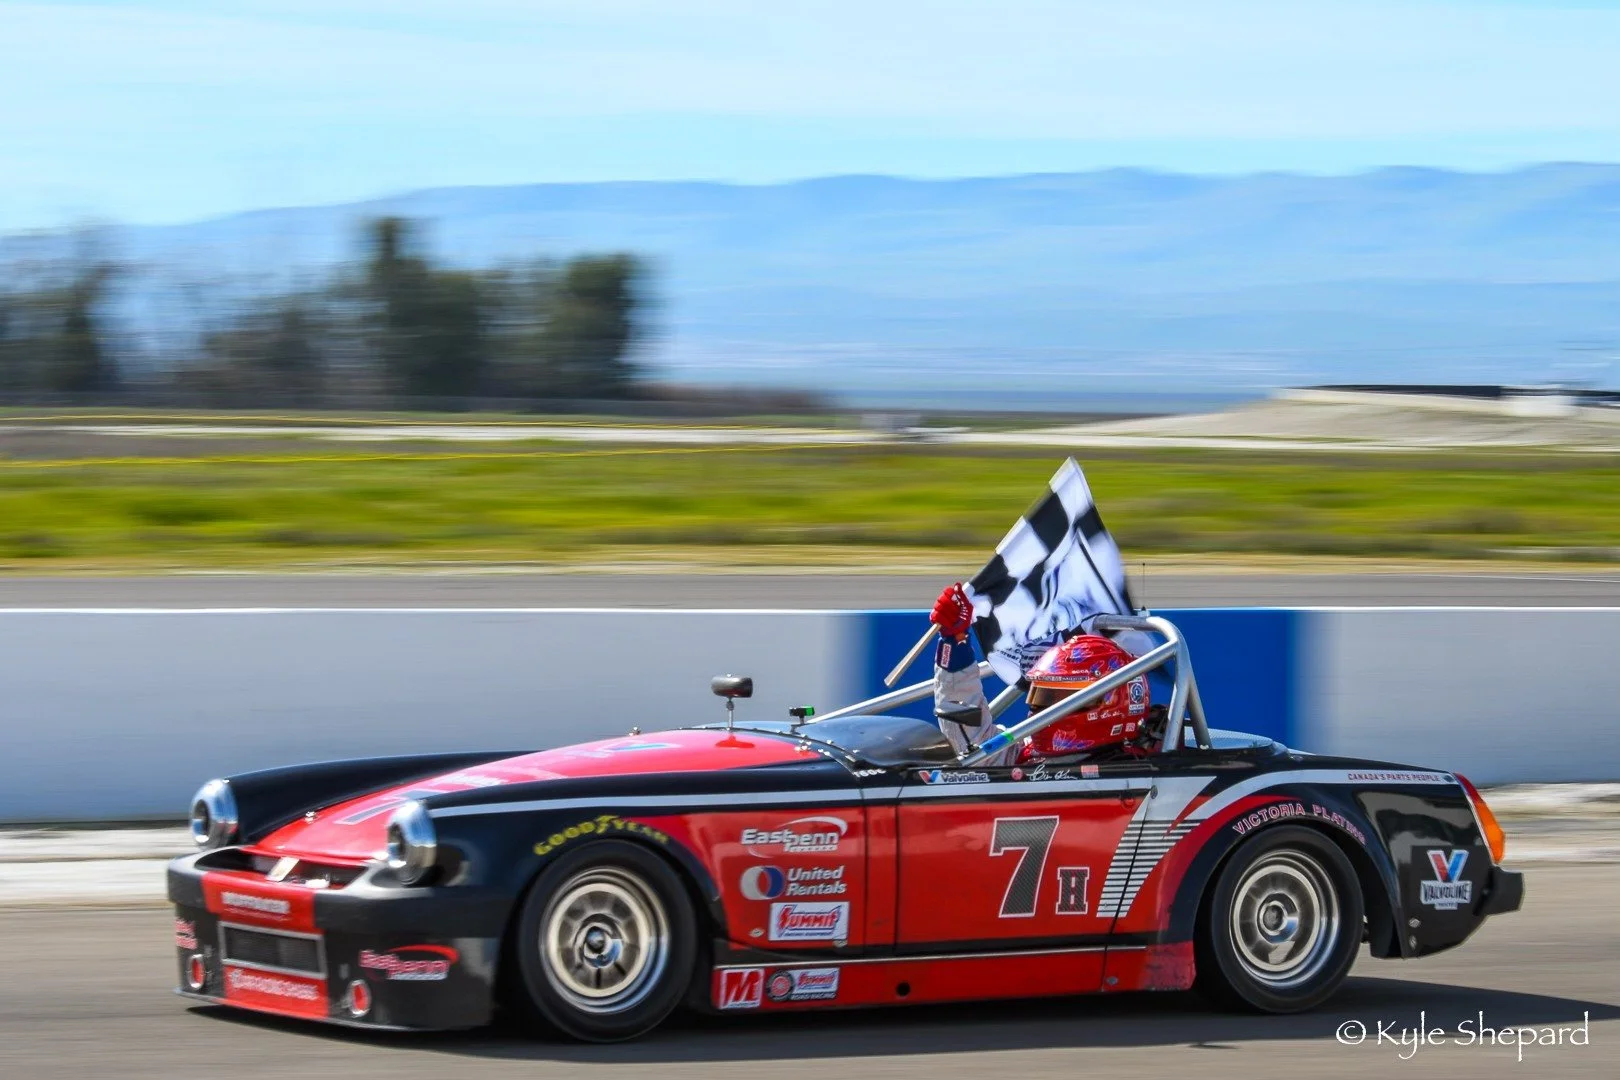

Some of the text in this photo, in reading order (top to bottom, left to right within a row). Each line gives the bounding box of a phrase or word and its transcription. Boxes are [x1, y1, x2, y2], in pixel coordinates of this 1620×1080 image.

[942, 771, 989, 784] Valvoline
[1232, 803, 1306, 835] VICTORIA
[787, 865, 845, 881] United
[988, 815, 1060, 918] 7
[786, 882, 848, 897] Rentals
